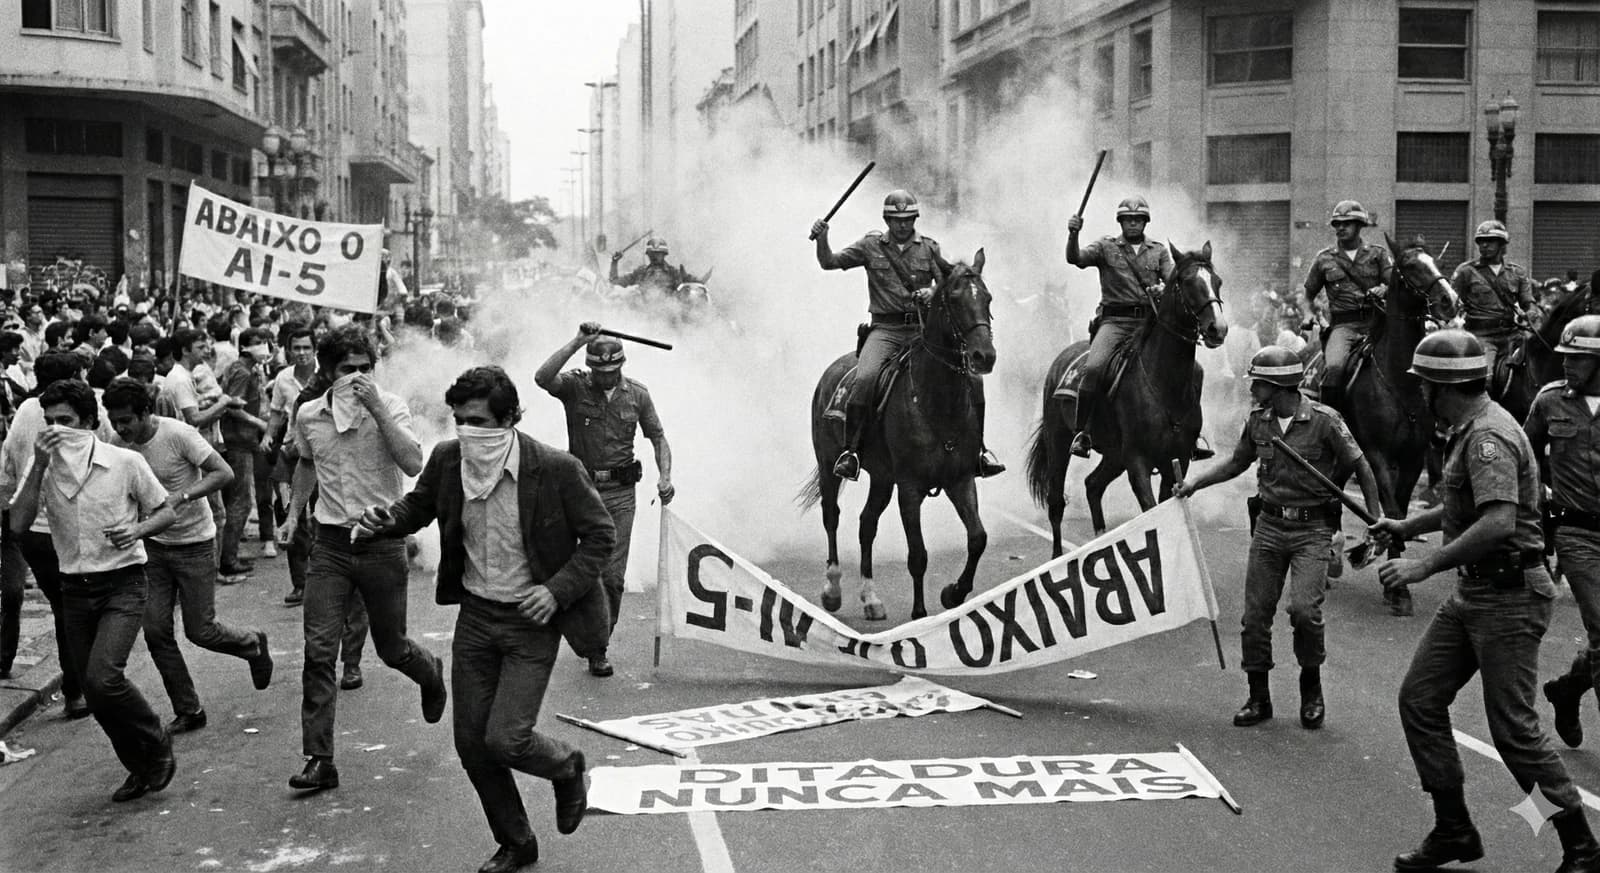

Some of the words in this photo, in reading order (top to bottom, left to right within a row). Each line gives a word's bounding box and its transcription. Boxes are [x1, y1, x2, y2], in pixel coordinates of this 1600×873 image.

[194, 198, 322, 255] ABAIXO
[340, 231, 364, 260] O
[224, 247, 326, 296] AI-5
[948, 528, 1166, 668] ABAIXO
[639, 783, 949, 809] NUNCA
[973, 776, 1198, 800] MAIS
[679, 758, 1168, 784] DITADURA
